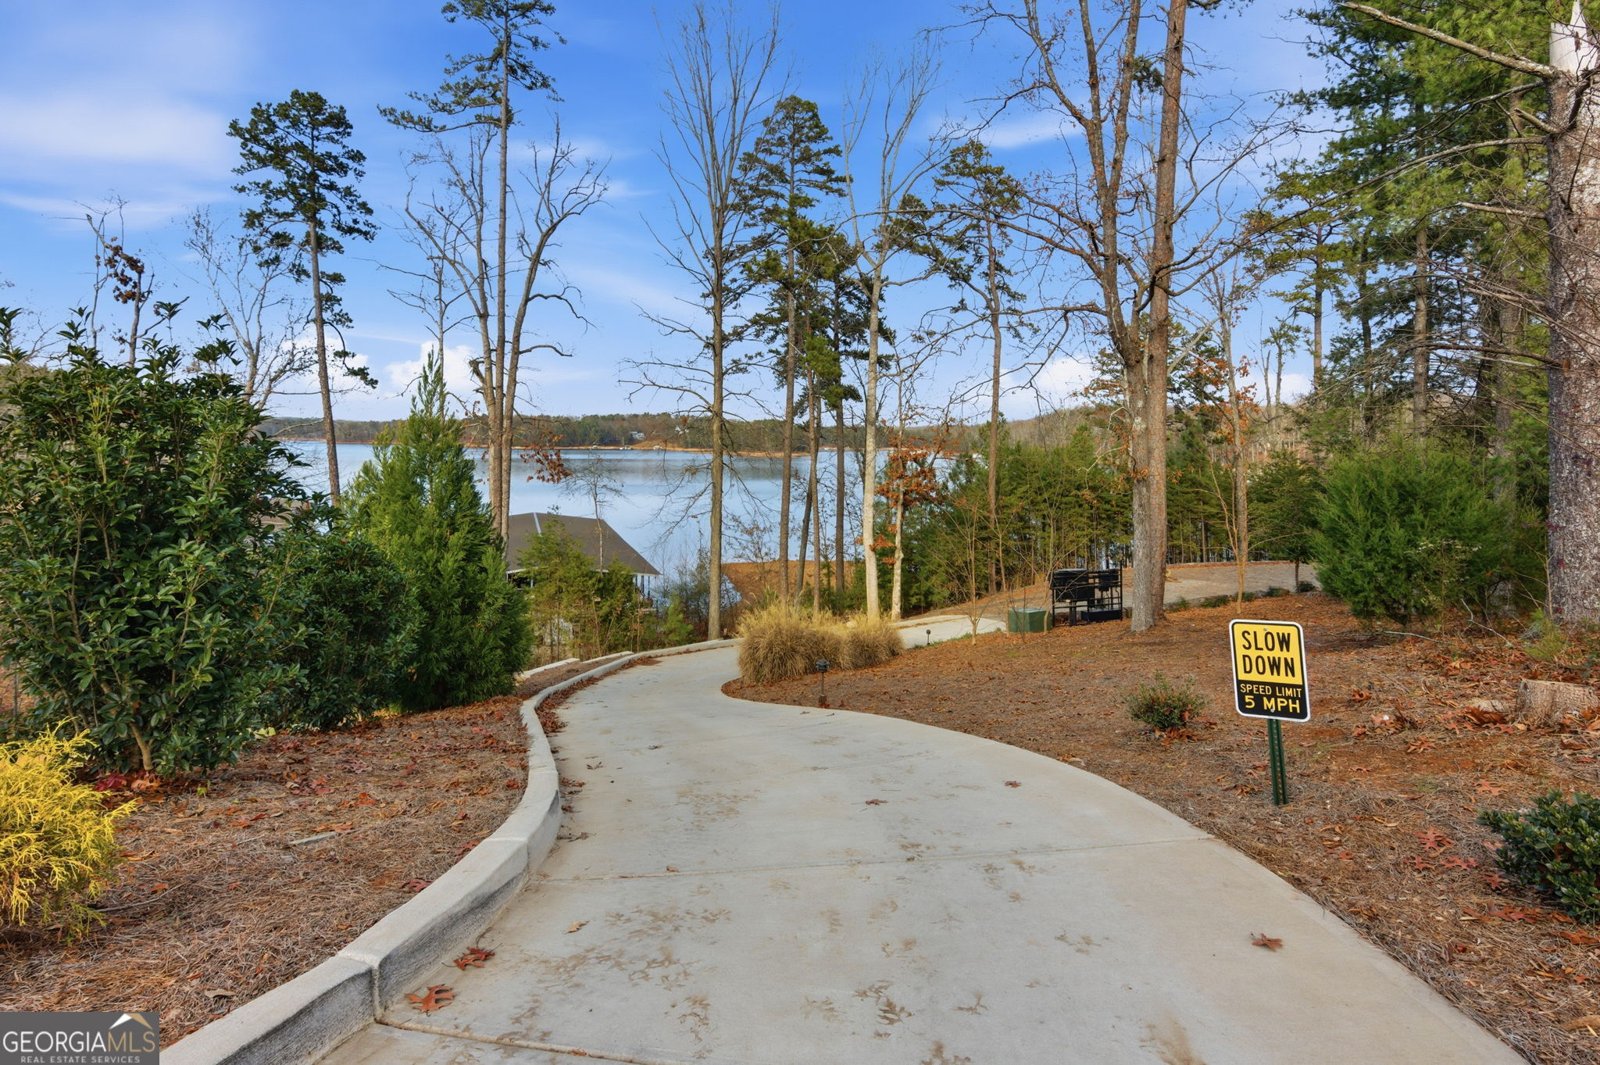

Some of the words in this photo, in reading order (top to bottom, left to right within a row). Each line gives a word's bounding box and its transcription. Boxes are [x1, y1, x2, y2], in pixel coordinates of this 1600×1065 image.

[1241, 630, 1291, 652] SLOW
[1242, 654, 1296, 678] DOWN
[1240, 683, 1272, 695] SPEED
[1275, 686, 1302, 698] LIMIT
[1244, 695, 1256, 709] 5
[1262, 697, 1301, 713] MPH
